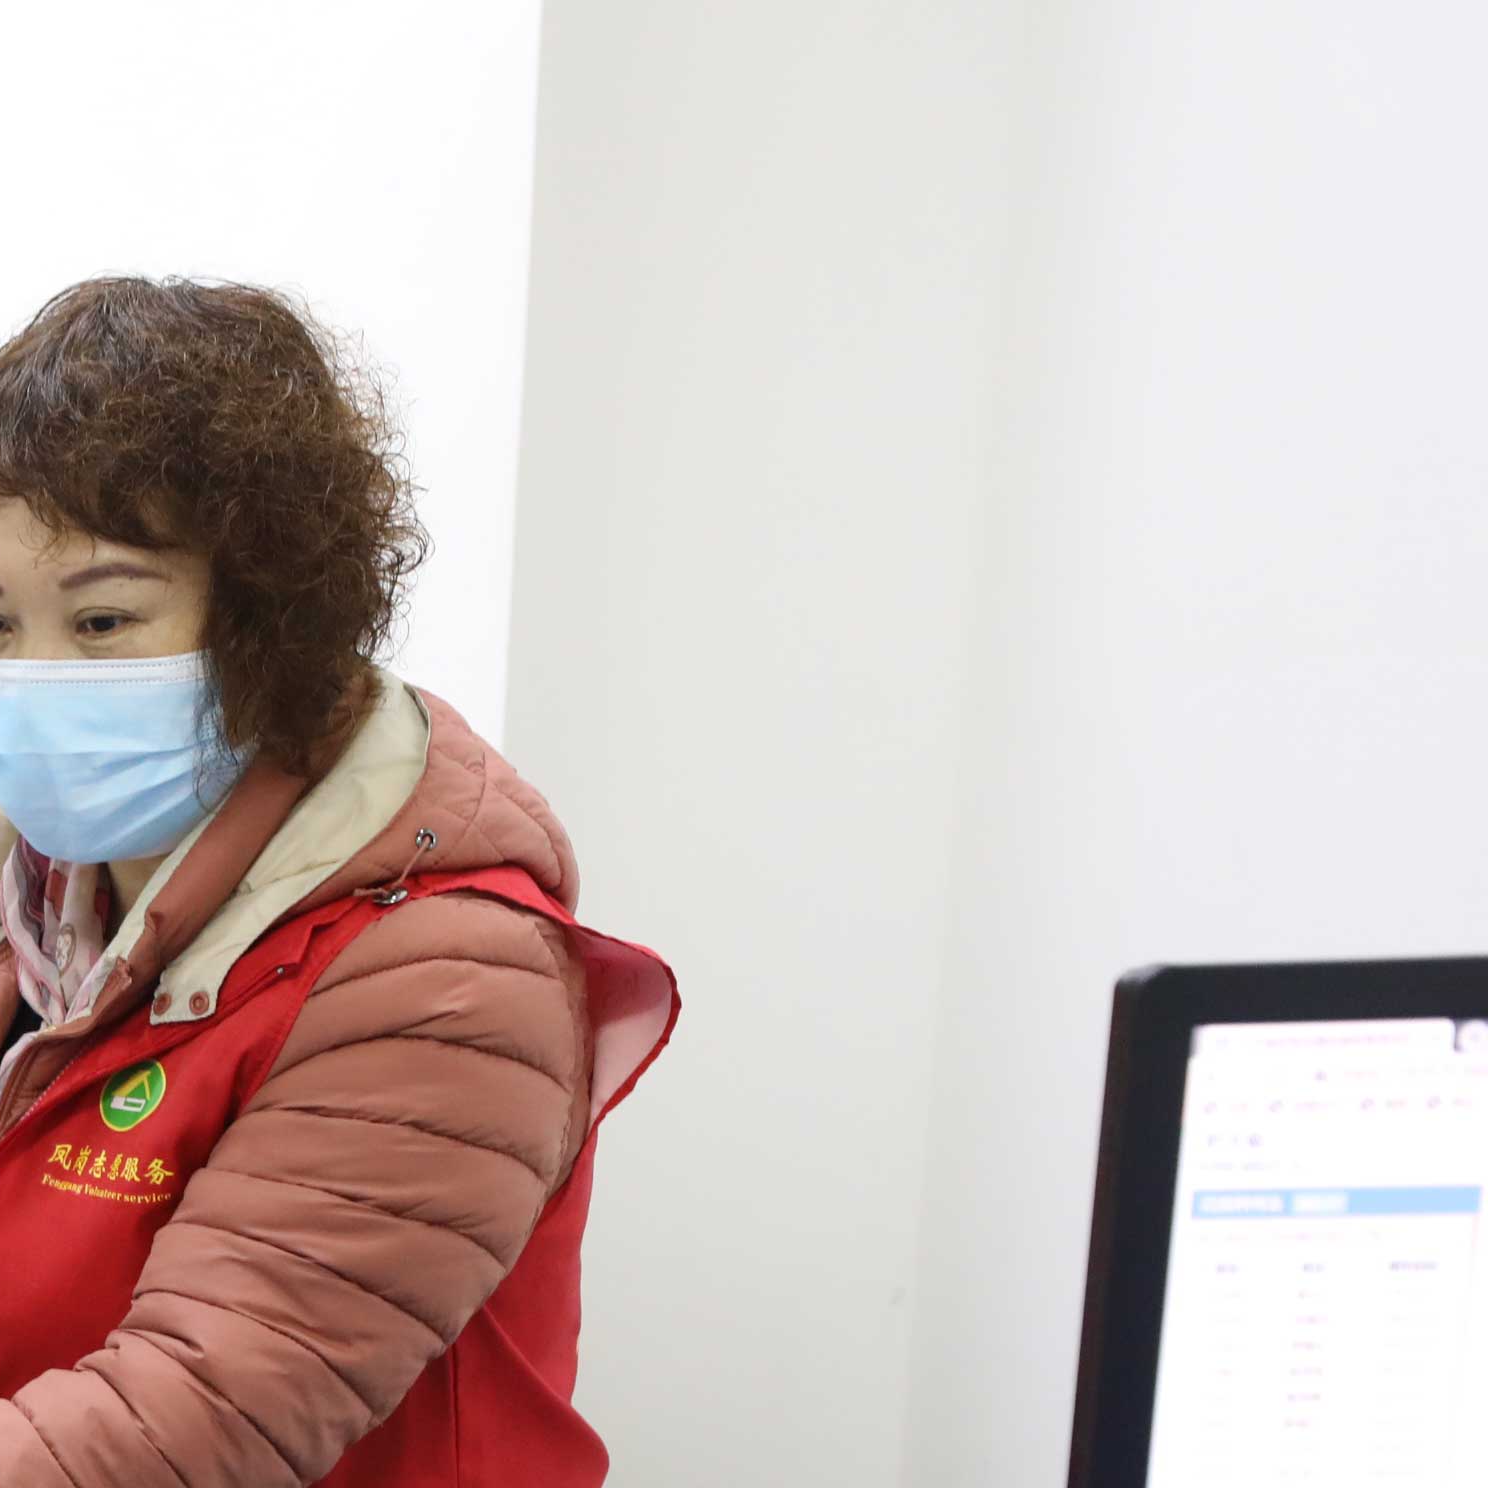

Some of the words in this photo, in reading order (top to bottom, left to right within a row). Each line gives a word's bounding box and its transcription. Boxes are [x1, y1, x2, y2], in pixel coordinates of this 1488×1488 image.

[48, 1143, 174, 1186] 凤岗志愿服务
[123, 1192, 172, 1205] service
